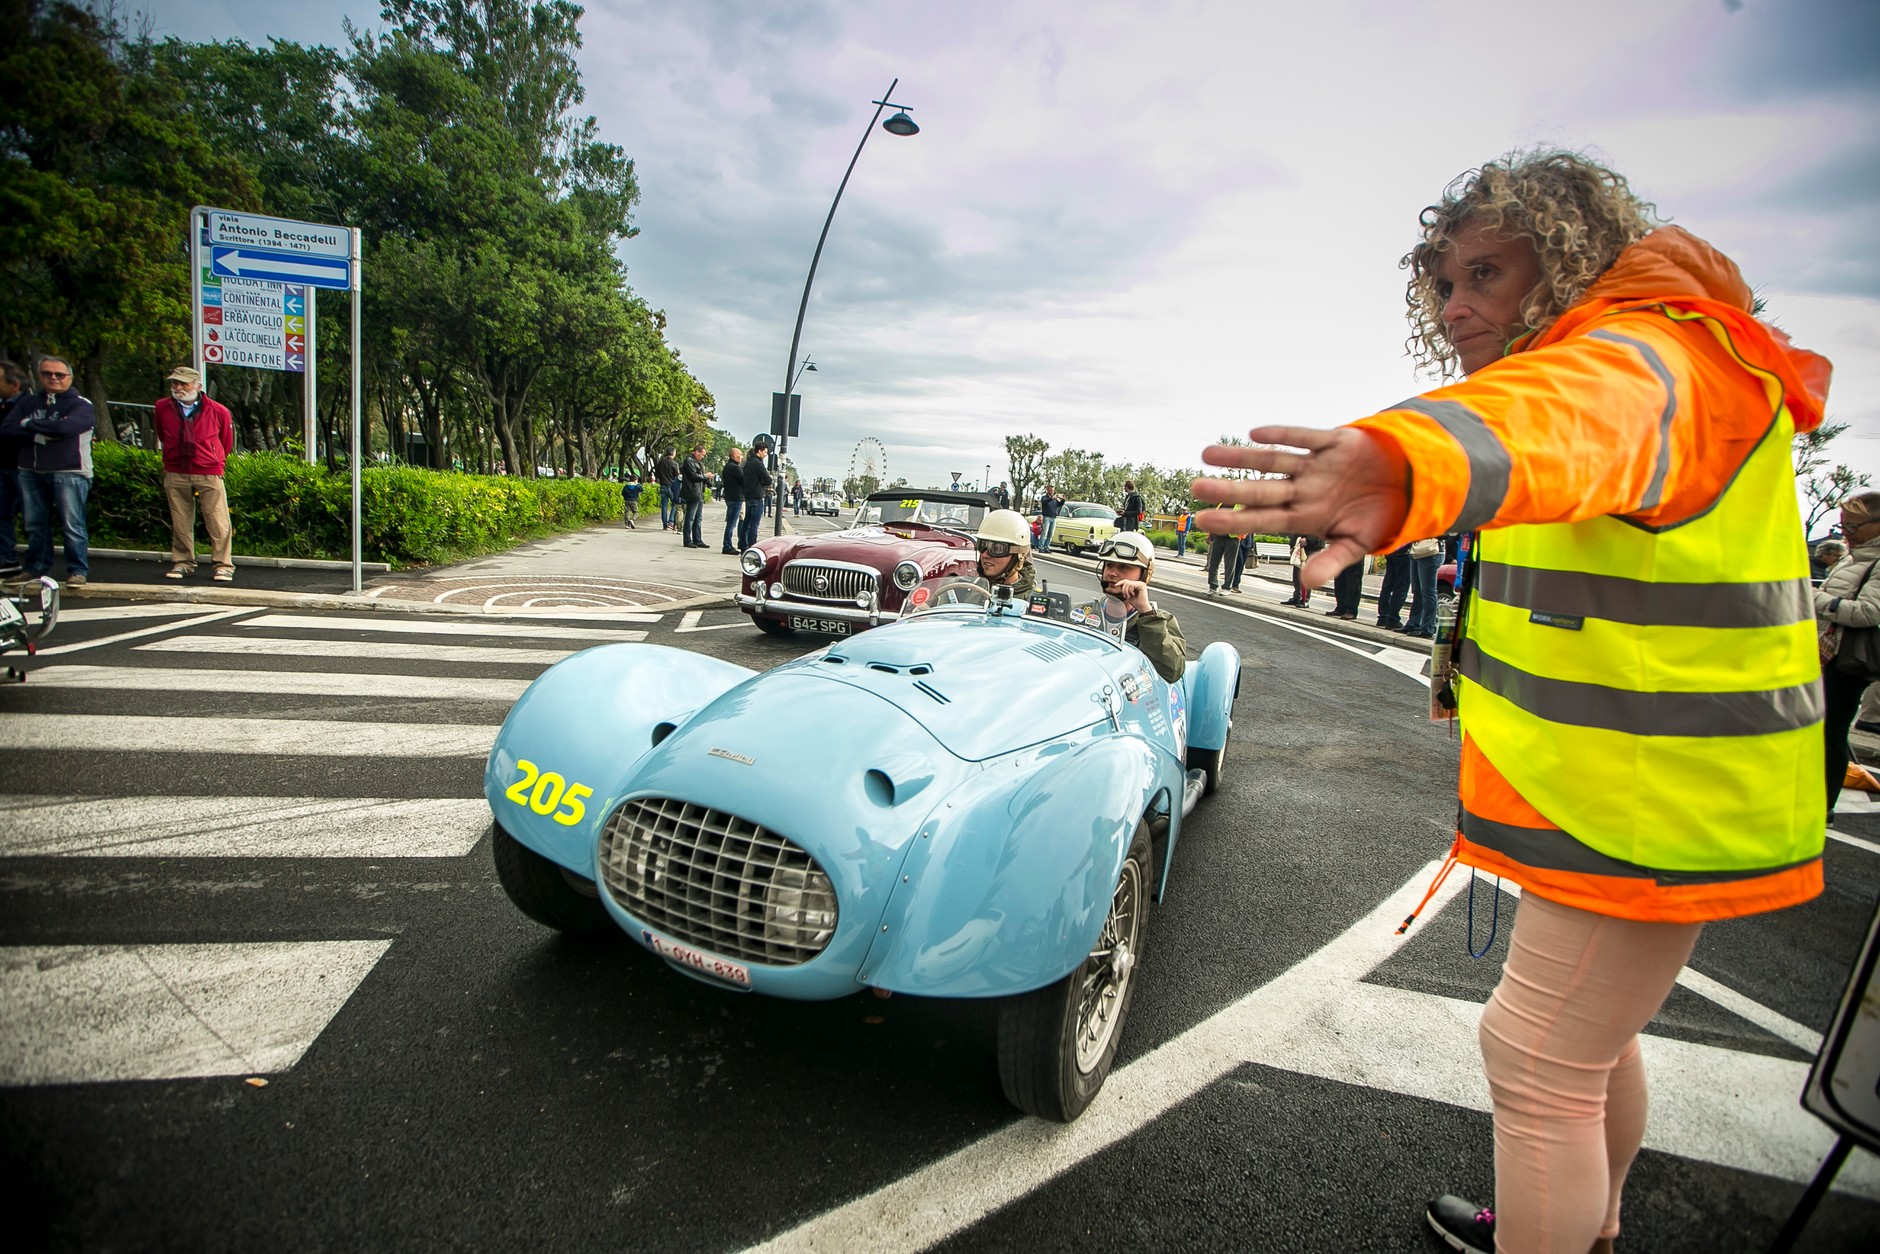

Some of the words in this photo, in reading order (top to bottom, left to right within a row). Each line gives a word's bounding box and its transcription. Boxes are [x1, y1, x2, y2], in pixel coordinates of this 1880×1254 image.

[218, 215, 239, 223] viale
[219, 223, 268, 237] Antonio
[274, 229, 337, 246] Beccadelli
[219, 234, 255, 244] Scrittore
[258, 239, 282, 248] (1394
[289, 242, 311, 251] 1471)
[223, 292, 282, 309] CONTINENTAL
[224, 311, 283, 327] ERBAVOGLIO
[224, 330, 235, 341] LA
[236, 331, 282, 347] COCCINELLA
[224, 350, 282, 366] VODAFONE
[900, 499, 918, 508] 215
[793, 616, 818, 631] 642
[820, 621, 846, 634] SPG
[505, 758, 594, 827] 205
